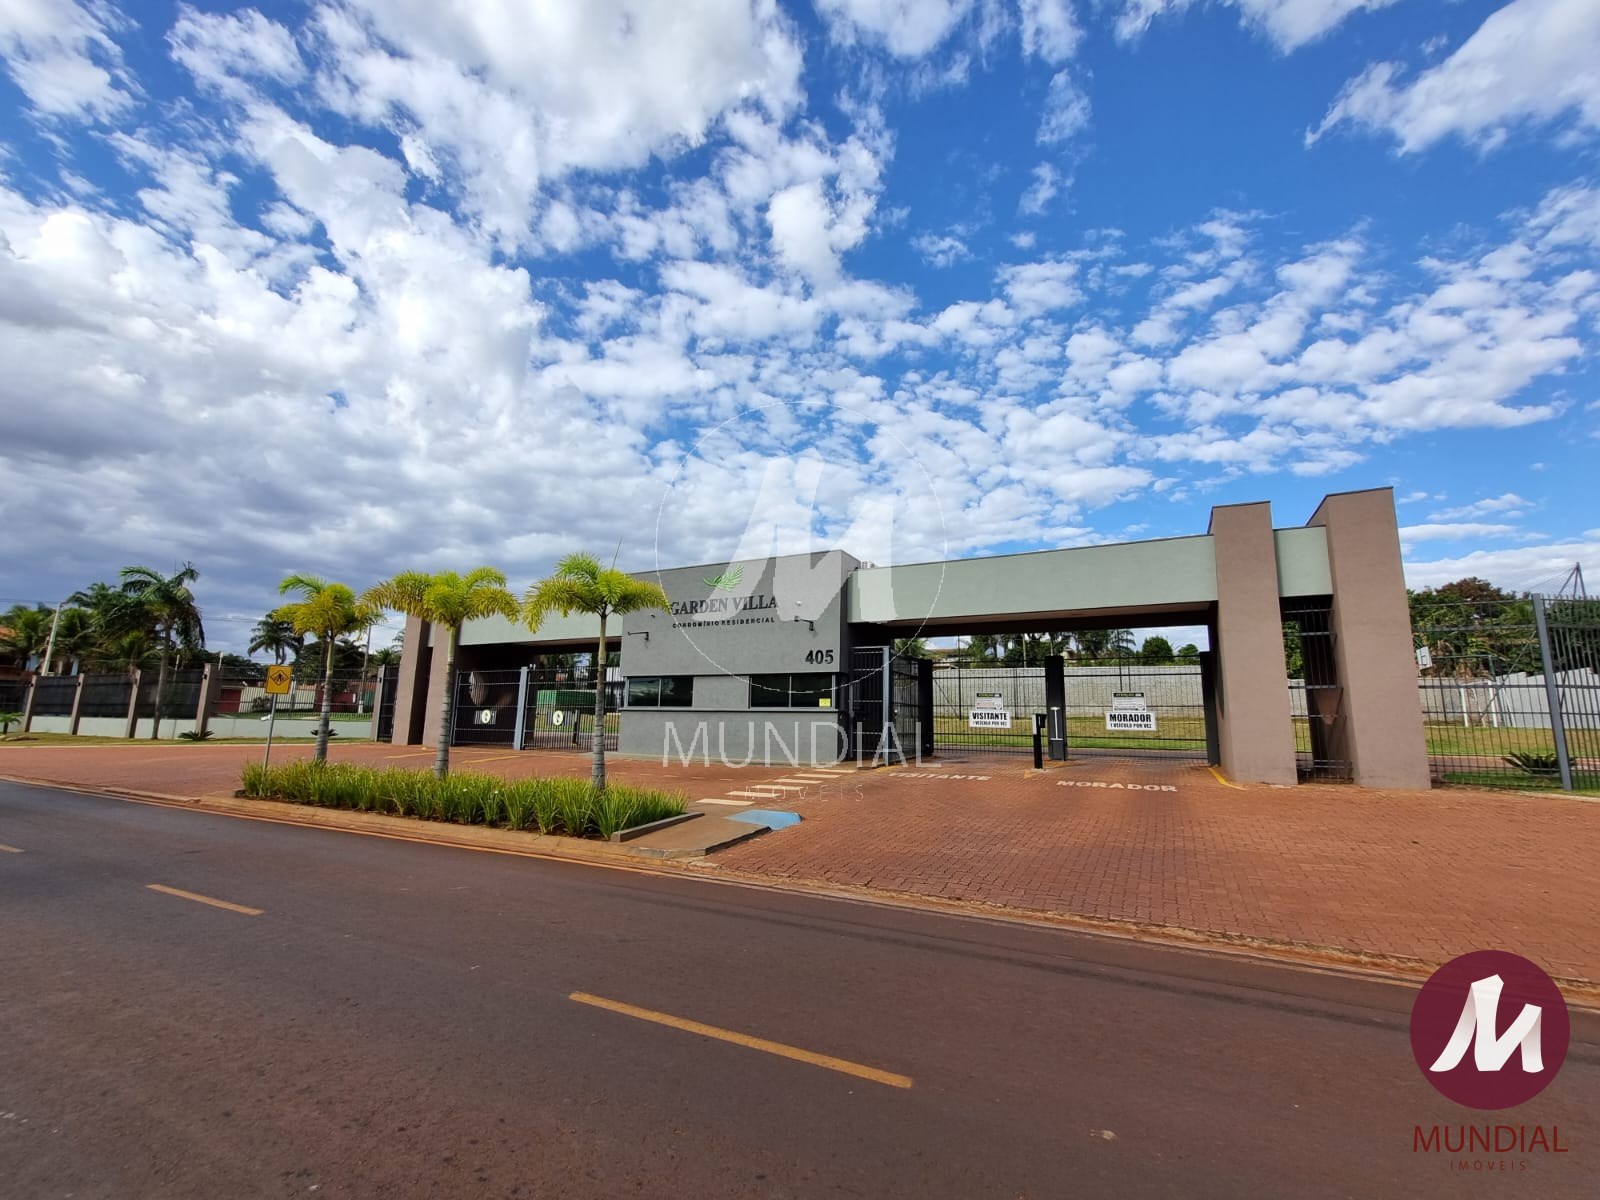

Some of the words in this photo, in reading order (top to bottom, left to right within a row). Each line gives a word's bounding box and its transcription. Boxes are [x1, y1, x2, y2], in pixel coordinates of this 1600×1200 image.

[671, 598, 729, 616] GARDEN
[732, 595, 778, 613] VILLA
[721, 617, 775, 626] RESIDENCIAL
[805, 649, 834, 665] 405
[972, 712, 1007, 720] VISITANTE
[1109, 713, 1152, 722] MORADOR
[1056, 780, 1178, 792] MORADOR
